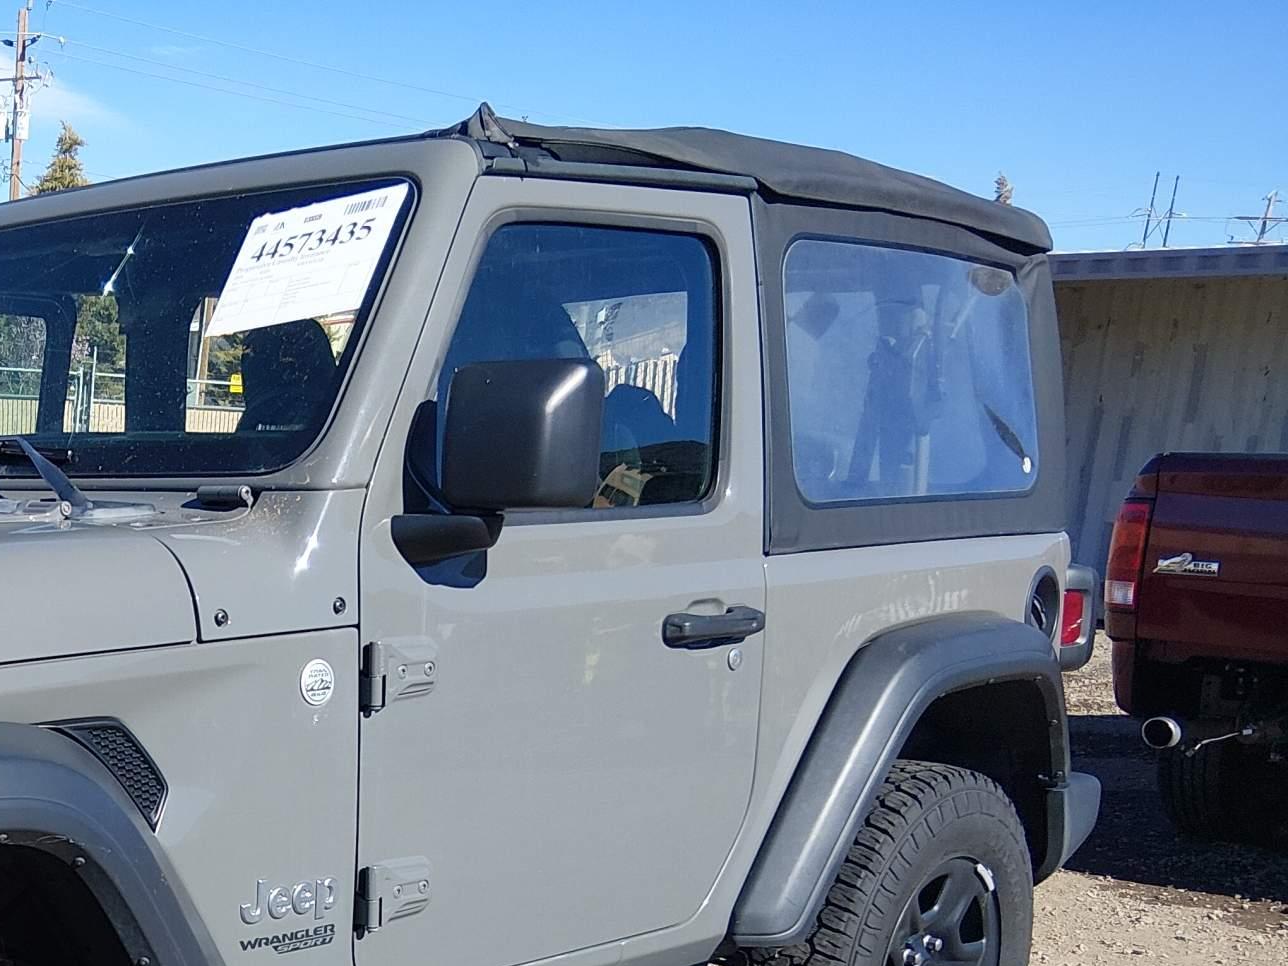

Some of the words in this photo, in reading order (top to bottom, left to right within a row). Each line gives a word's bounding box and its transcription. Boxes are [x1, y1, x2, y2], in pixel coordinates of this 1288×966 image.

[251, 218, 377, 262] 44573435
[240, 877, 337, 925] Jeep
[239, 923, 335, 951] WRANGLER
[276, 936, 333, 953] SPORT
